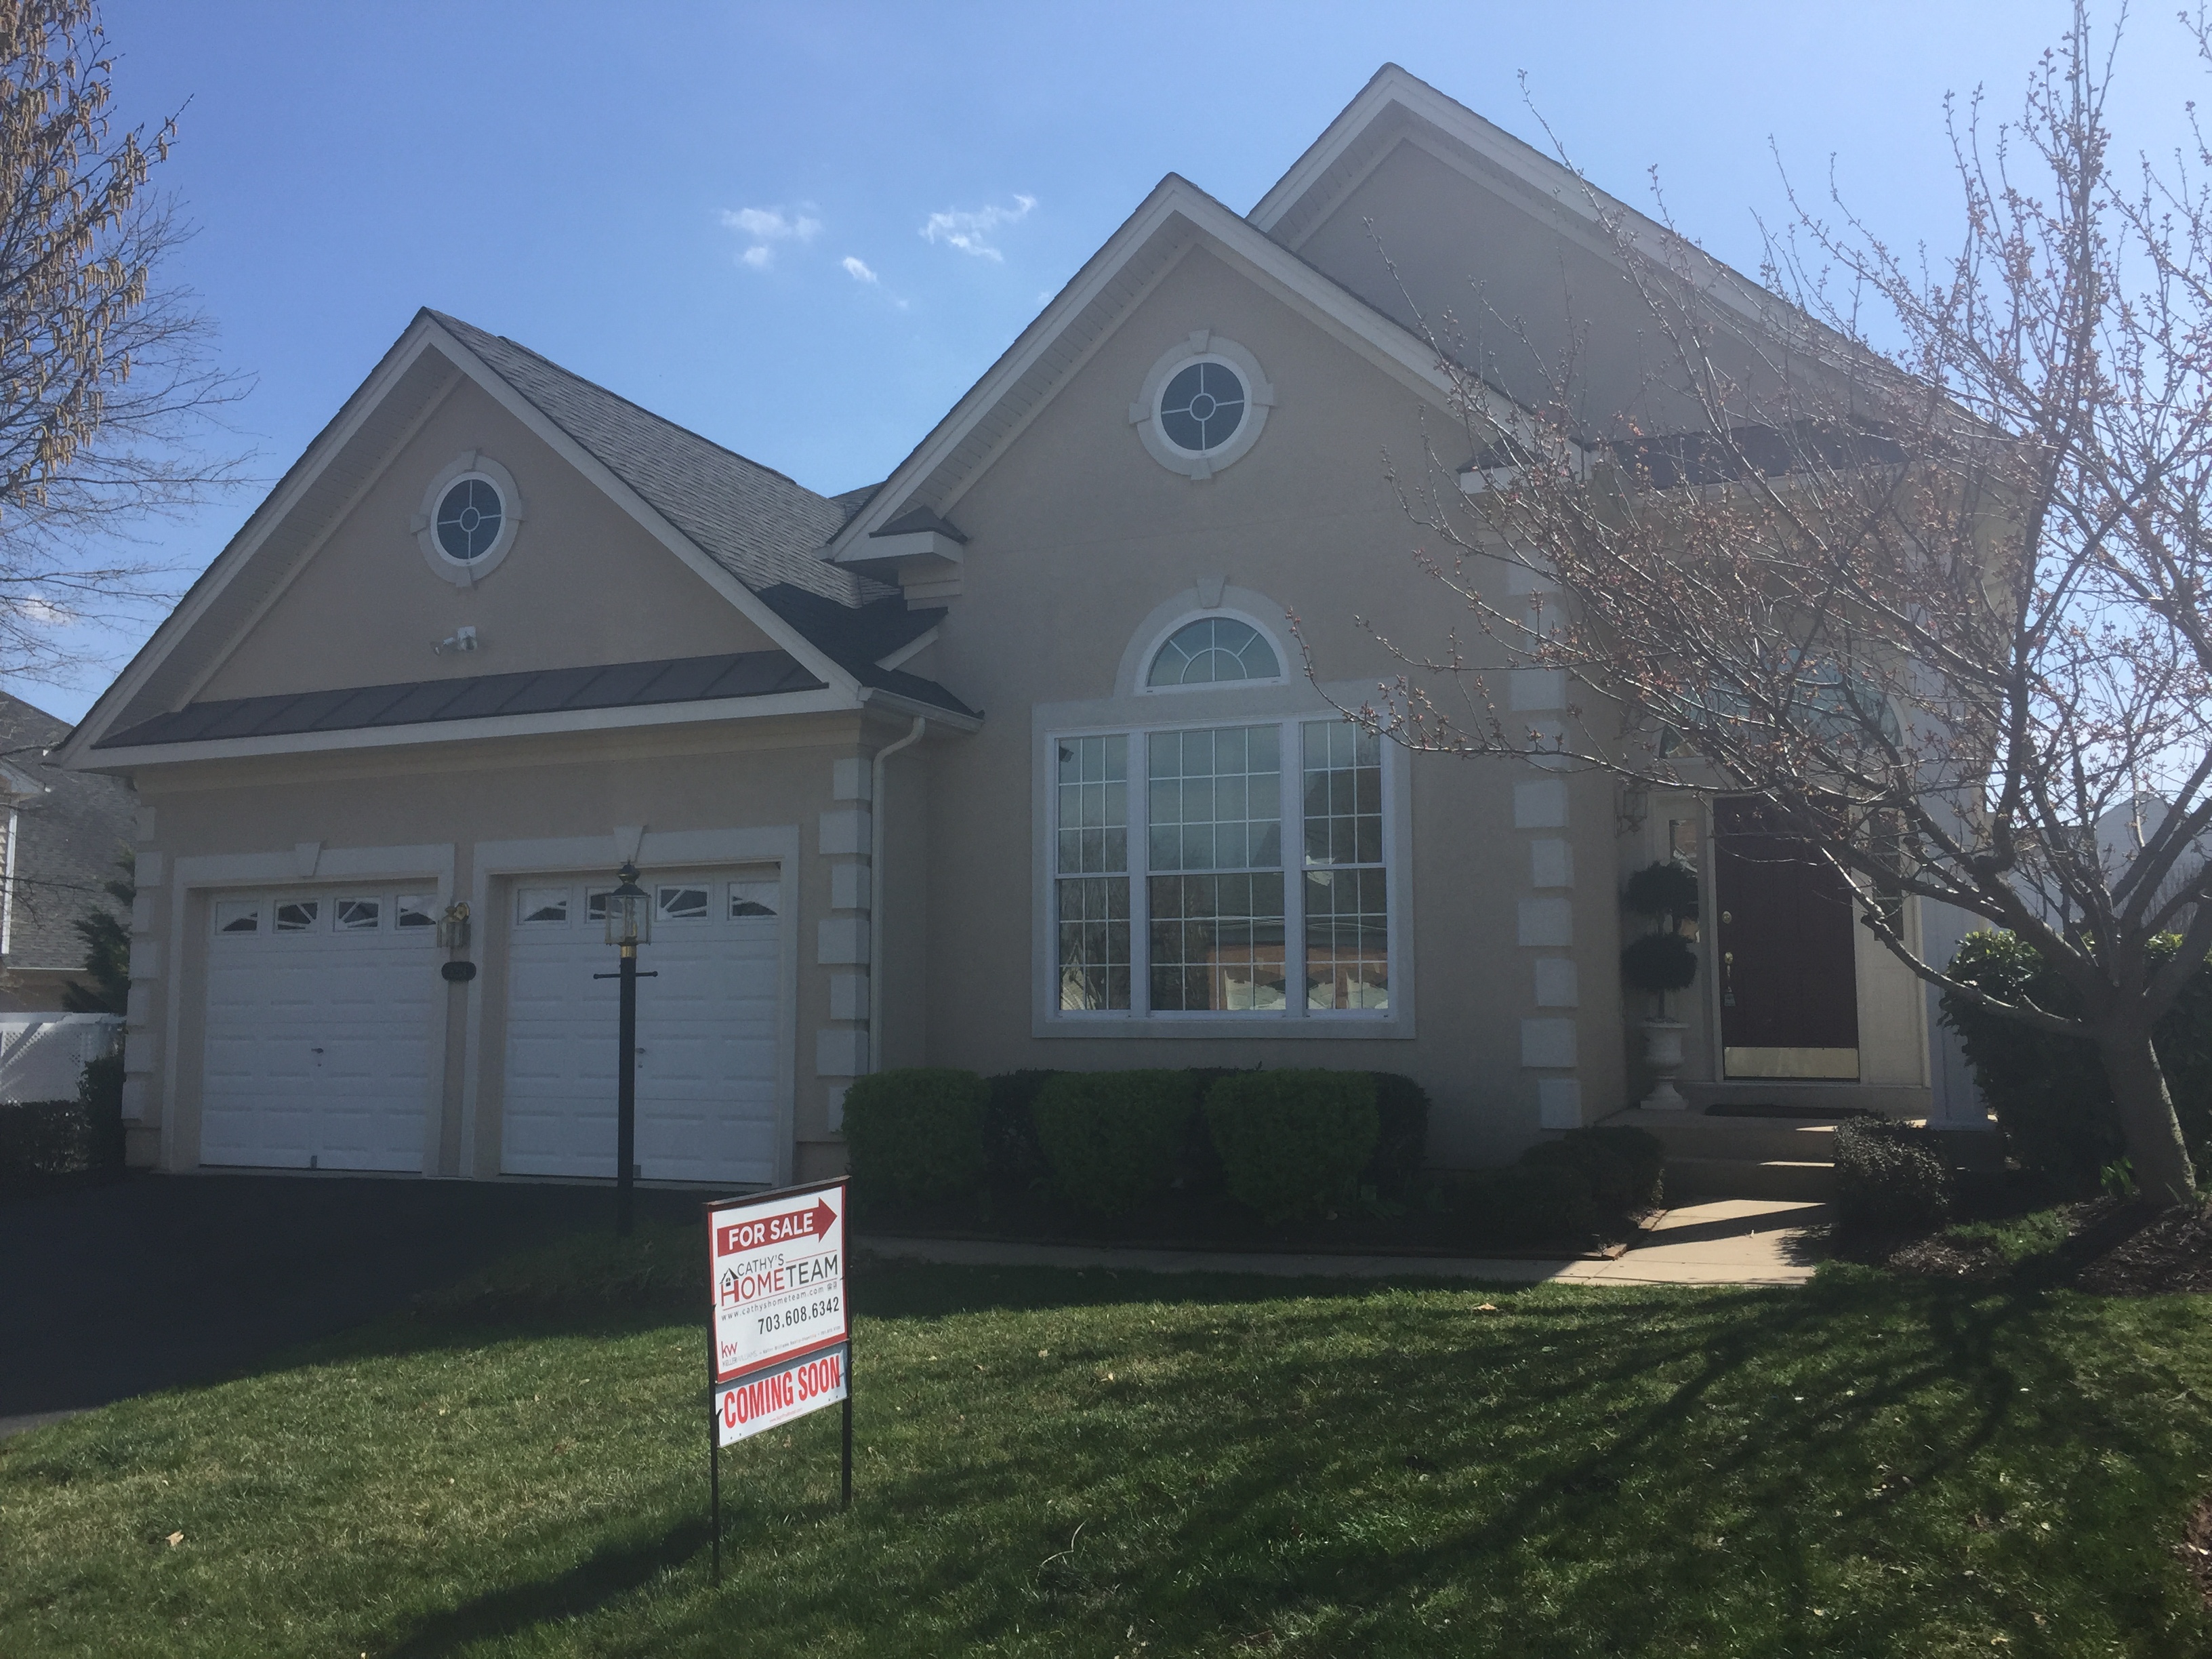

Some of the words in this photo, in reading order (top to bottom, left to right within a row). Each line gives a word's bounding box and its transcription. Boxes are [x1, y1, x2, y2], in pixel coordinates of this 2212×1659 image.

[729, 1223, 765, 1250] FOR
[771, 1212, 813, 1240] SALE
[737, 1253, 785, 1277] CATHY'S
[721, 1286, 824, 1322] www.cathyshometeam.com
[758, 1296, 840, 1335] 703.608.6342
[721, 1340, 738, 1359] kw
[724, 1370, 794, 1429] COMING
[798, 1355, 841, 1401] SOON
